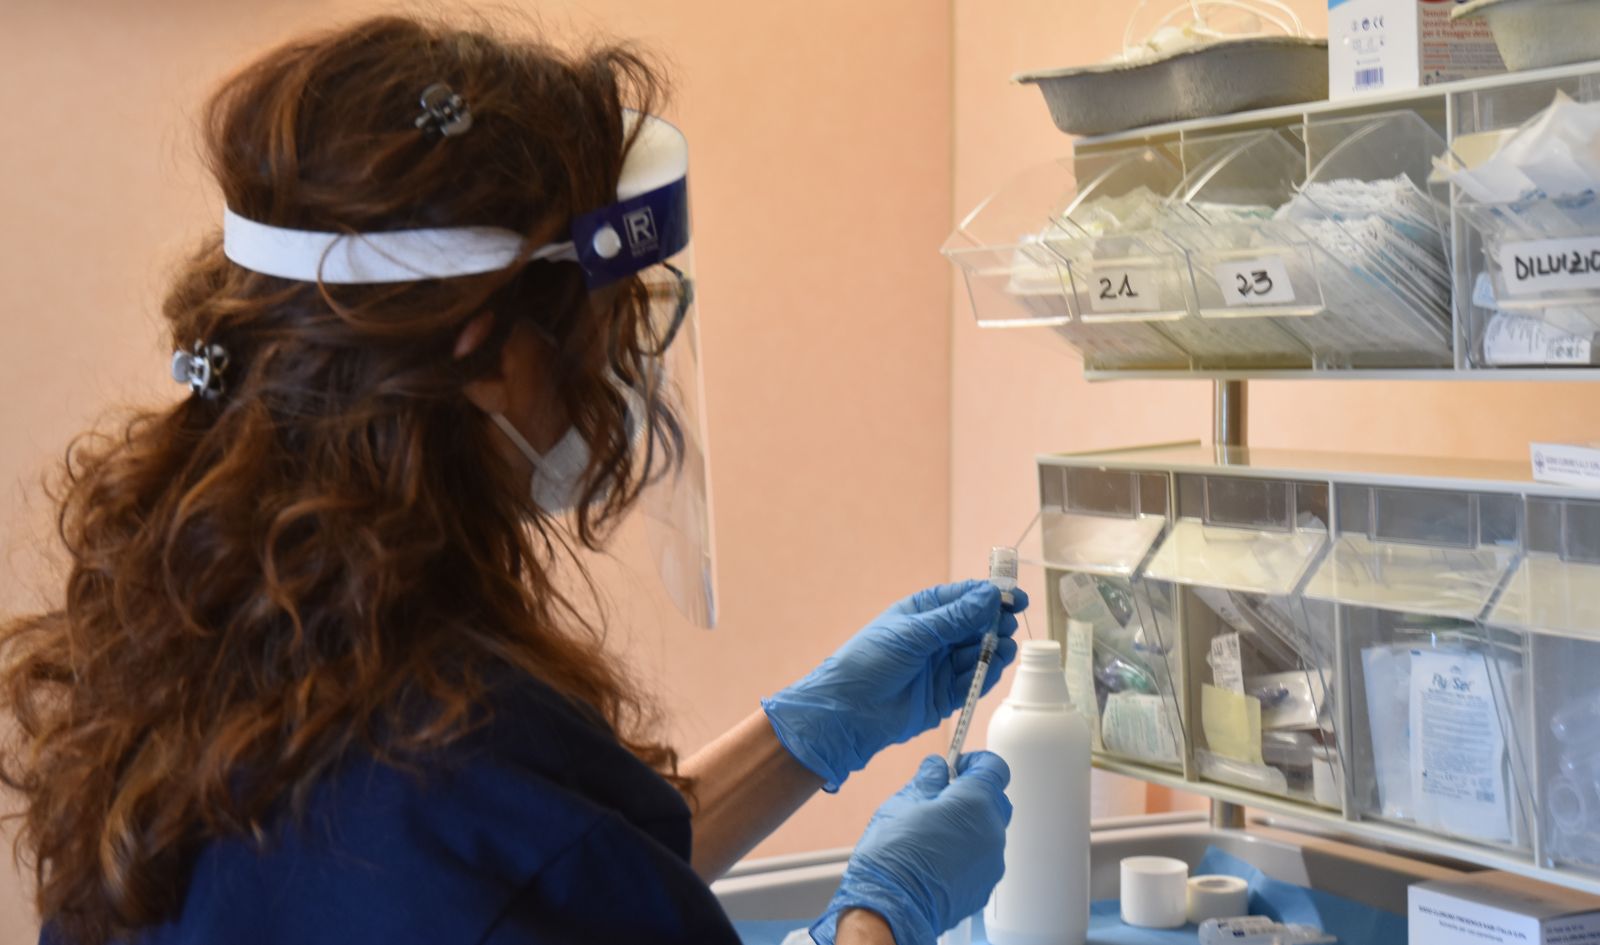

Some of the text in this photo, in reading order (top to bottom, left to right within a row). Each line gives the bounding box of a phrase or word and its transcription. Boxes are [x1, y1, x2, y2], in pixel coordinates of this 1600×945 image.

[628, 212, 654, 244] R
[1099, 273, 1139, 300] 21
[1236, 269, 1273, 297] 23
